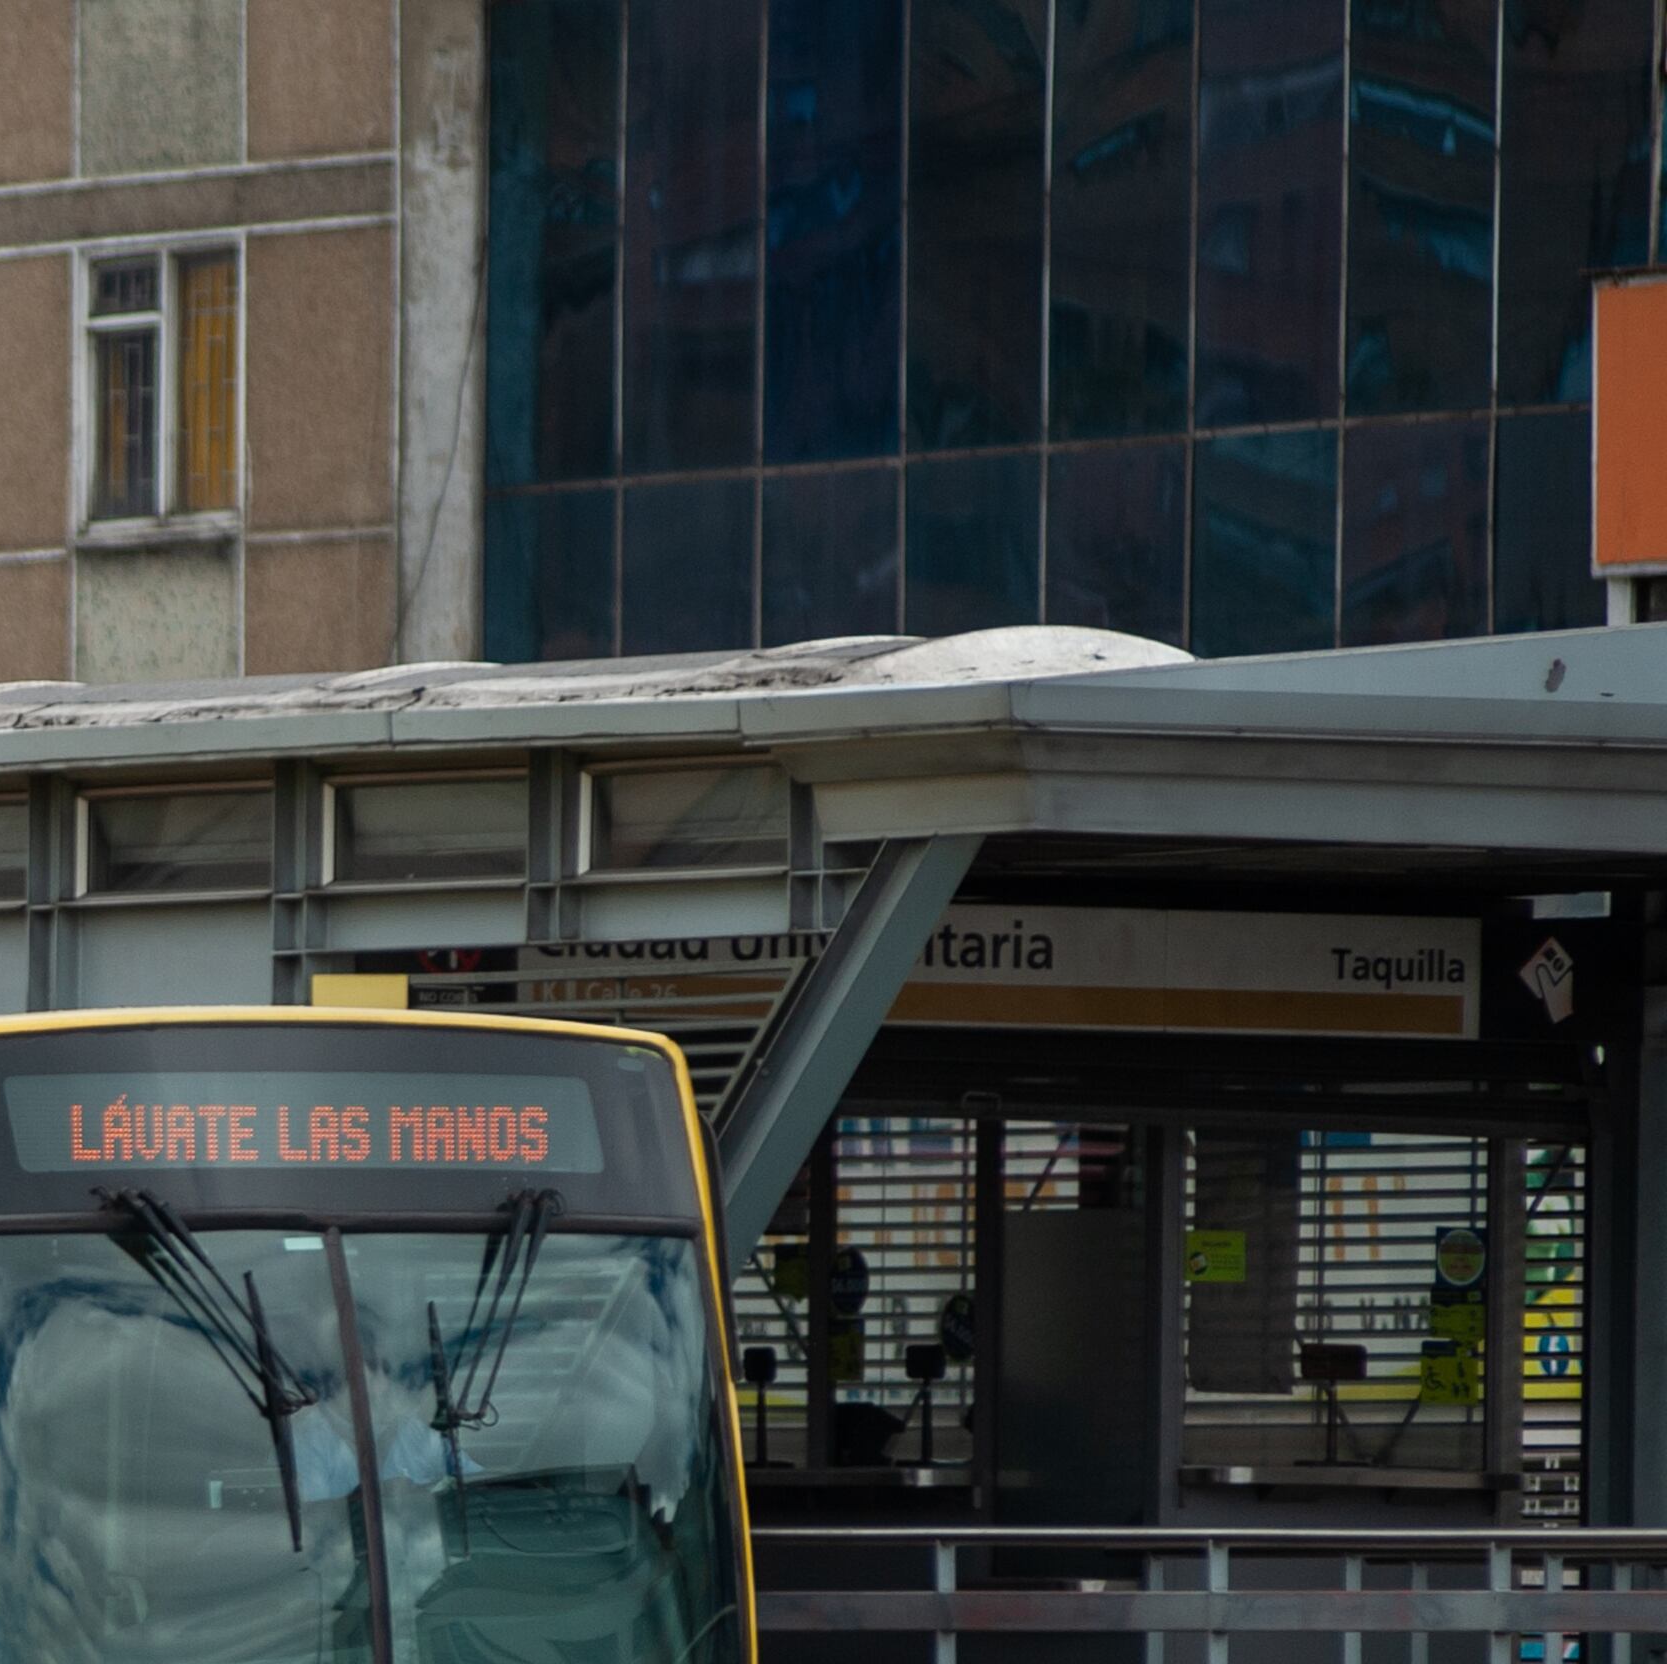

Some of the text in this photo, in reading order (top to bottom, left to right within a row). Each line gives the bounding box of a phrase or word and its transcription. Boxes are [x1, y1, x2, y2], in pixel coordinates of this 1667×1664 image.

[1331, 947, 1465, 989] Taquilla
[278, 1106, 372, 1162] LAS
[390, 1106, 549, 1164] MANOS
